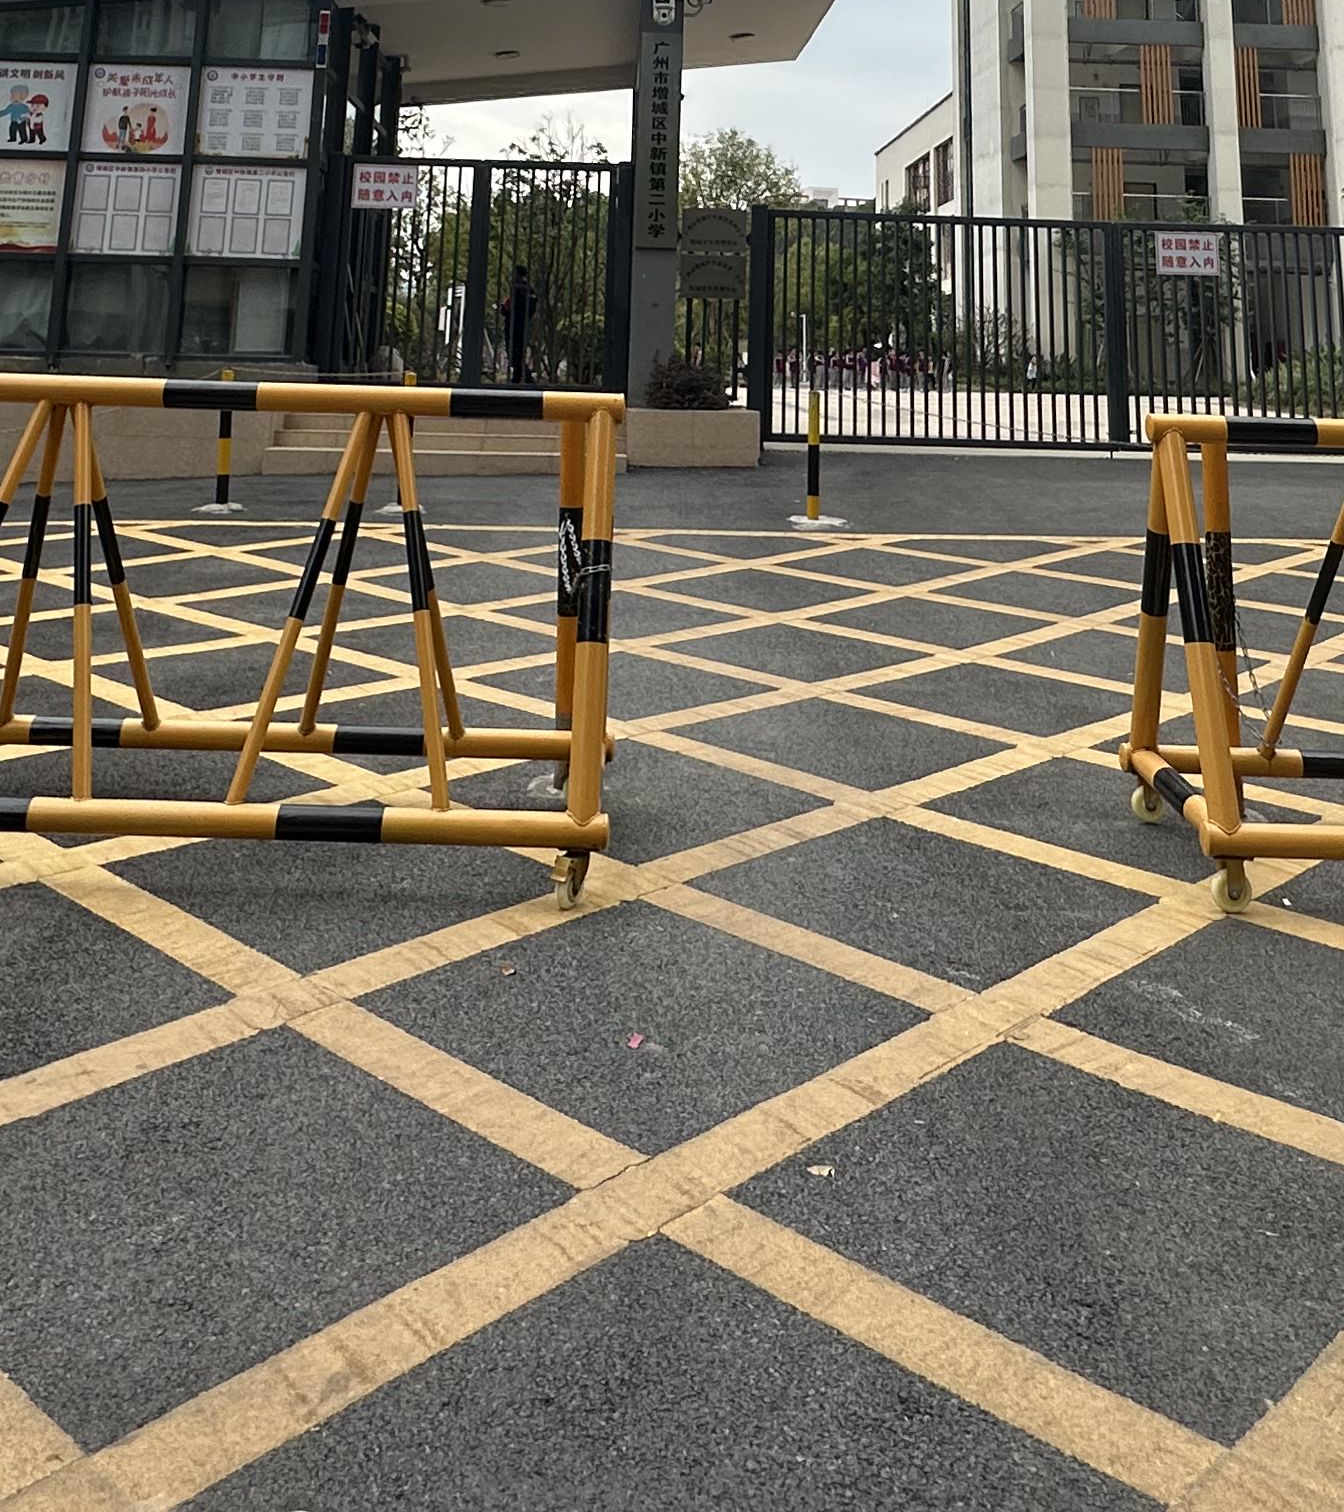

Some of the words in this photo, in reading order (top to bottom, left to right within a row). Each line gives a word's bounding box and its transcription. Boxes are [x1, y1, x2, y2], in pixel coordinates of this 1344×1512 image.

[647, 41, 669, 238] 广州市增城区中新镇第二小学
[359, 171, 414, 185] 校园禁止
[357, 189, 413, 203] 随意入内
[1161, 238, 1214, 251] 校园禁止
[1162, 256, 1214, 269] 随意入内
